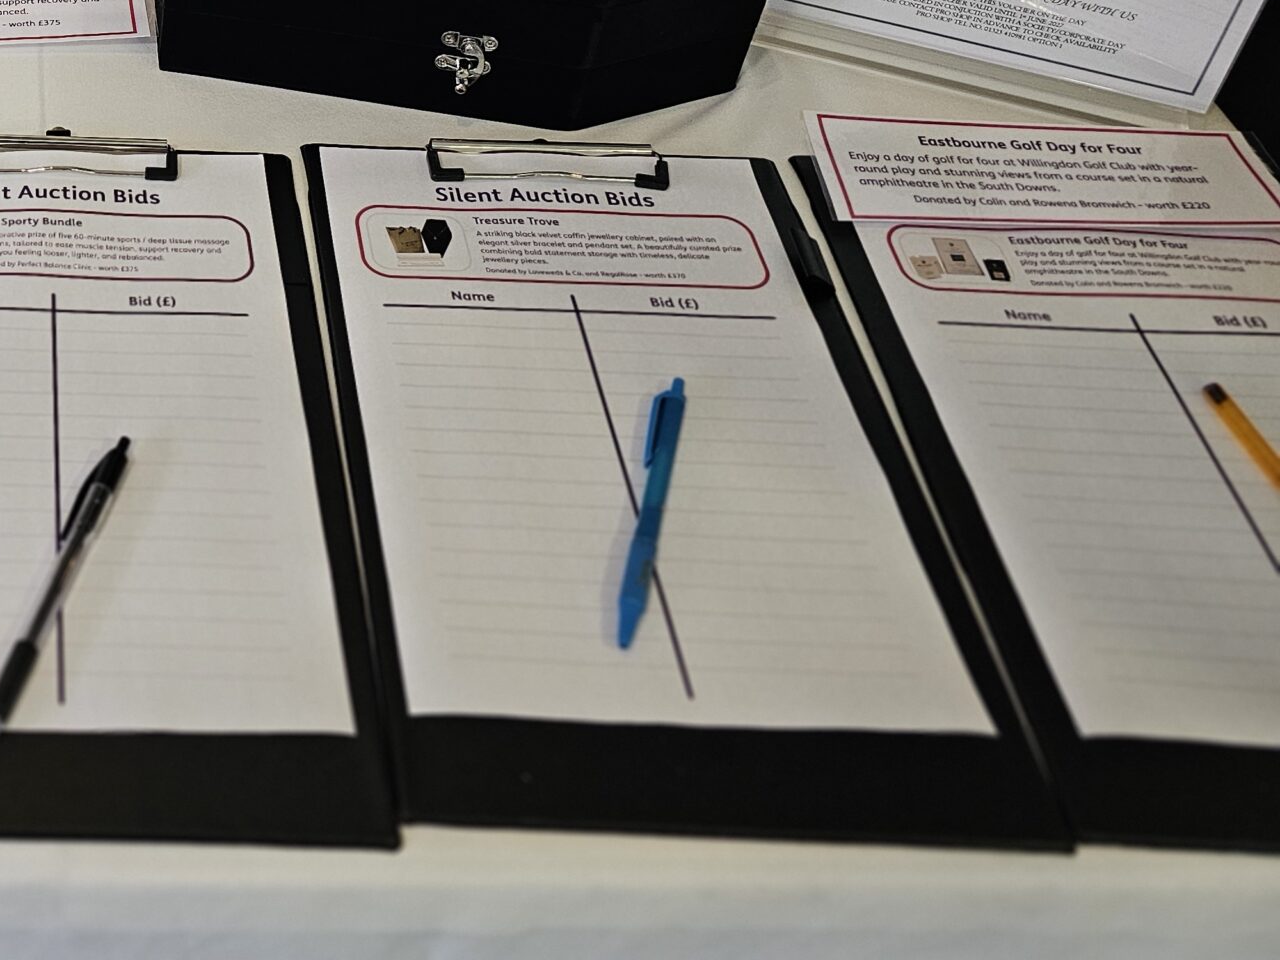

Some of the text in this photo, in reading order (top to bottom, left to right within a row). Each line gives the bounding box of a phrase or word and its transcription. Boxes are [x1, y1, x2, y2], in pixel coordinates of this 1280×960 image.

[917, 135, 1141, 155] Eastbourne Golf Day for Four
[18, 185, 106, 202] Auction
[113, 189, 160, 205] Bids
[435, 186, 655, 207] Silent Auction Bids
[1, 217, 39, 227] Sporty
[42, 217, 83, 227] Bundle
[472, 216, 559, 226] Treasure Trove
[1007, 236, 1188, 249] Eastbourne Golf Day for Four
[129, 296, 176, 308] Bid (£)
[451, 291, 495, 302] Name
[649, 297, 699, 311] Bid (£)
[1004, 309, 1052, 322] Name
[1212, 315, 1268, 329] Bid (£)
